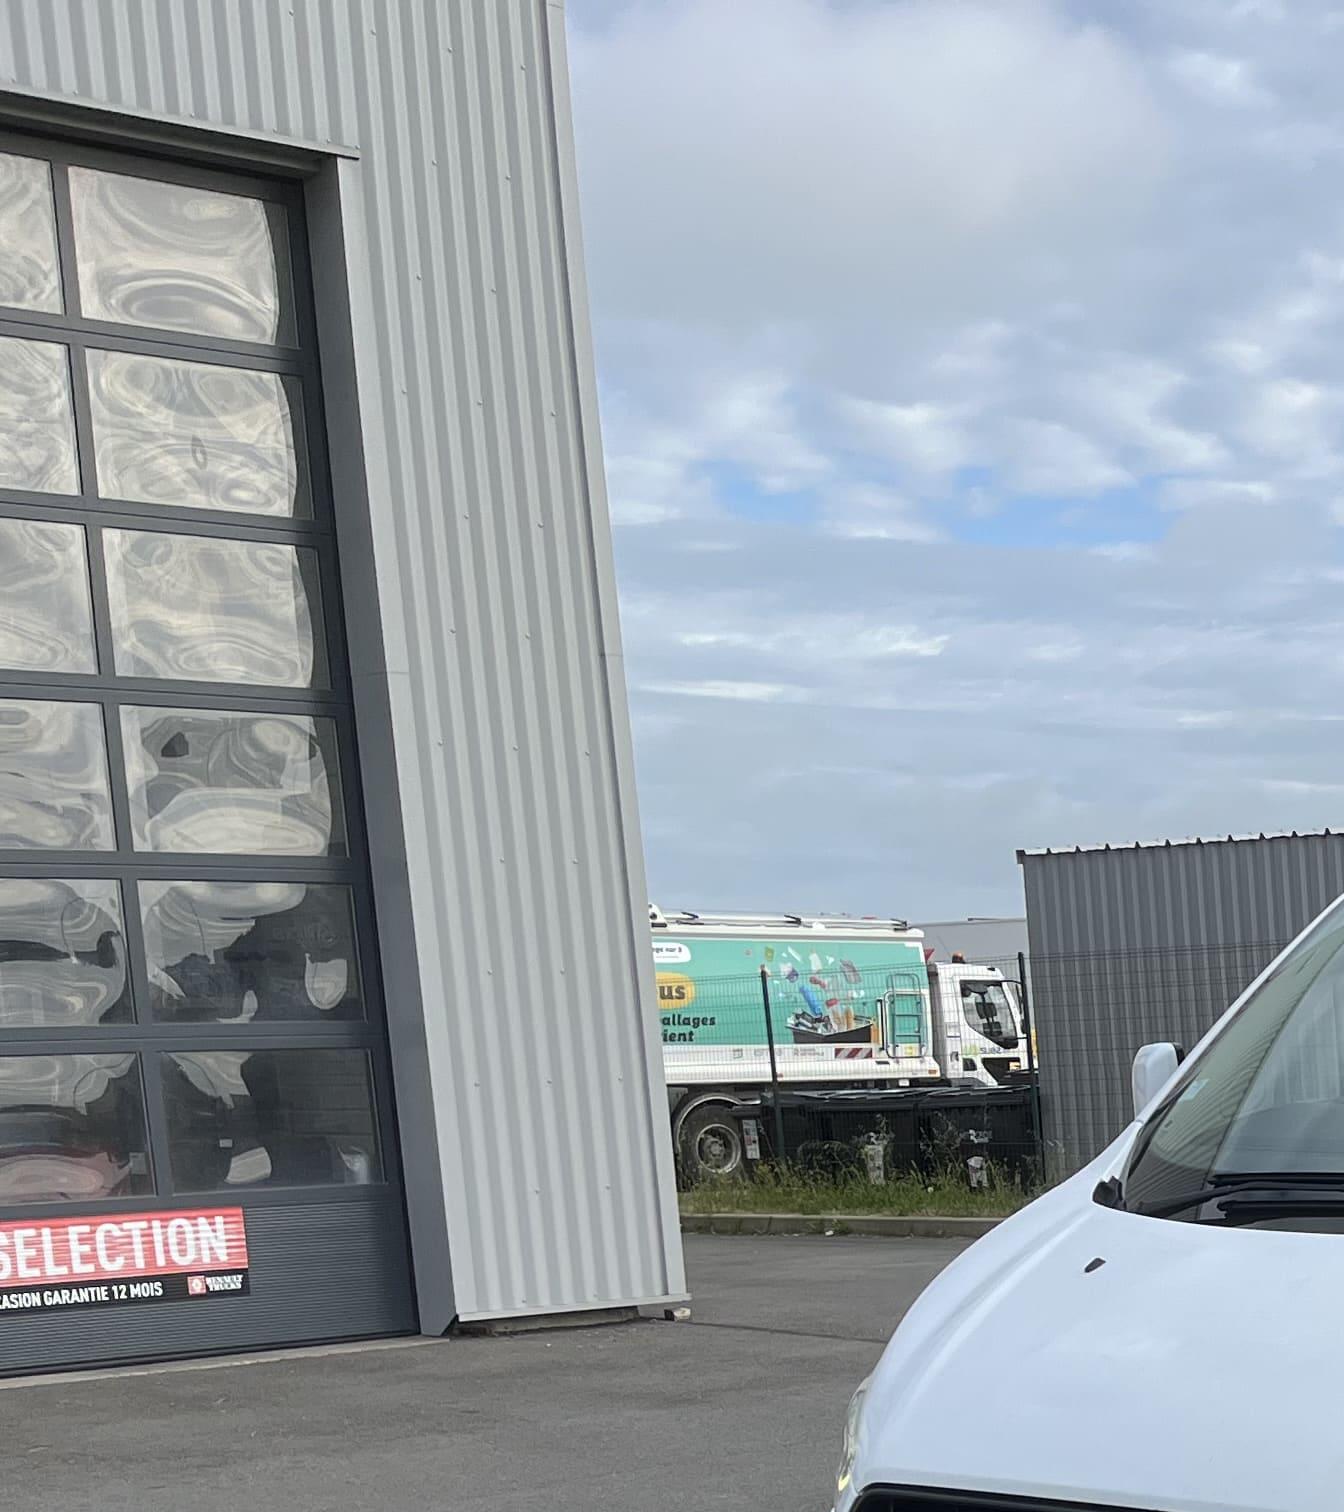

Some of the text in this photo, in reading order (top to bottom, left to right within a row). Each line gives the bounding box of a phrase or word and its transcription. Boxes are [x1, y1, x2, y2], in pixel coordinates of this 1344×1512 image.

[659, 985, 685, 1000] us
[662, 1014, 716, 1029] allages
[662, 1029, 695, 1042] ient
[0, 1282, 163, 1309] ASION GARANTIE 12 MOIS
